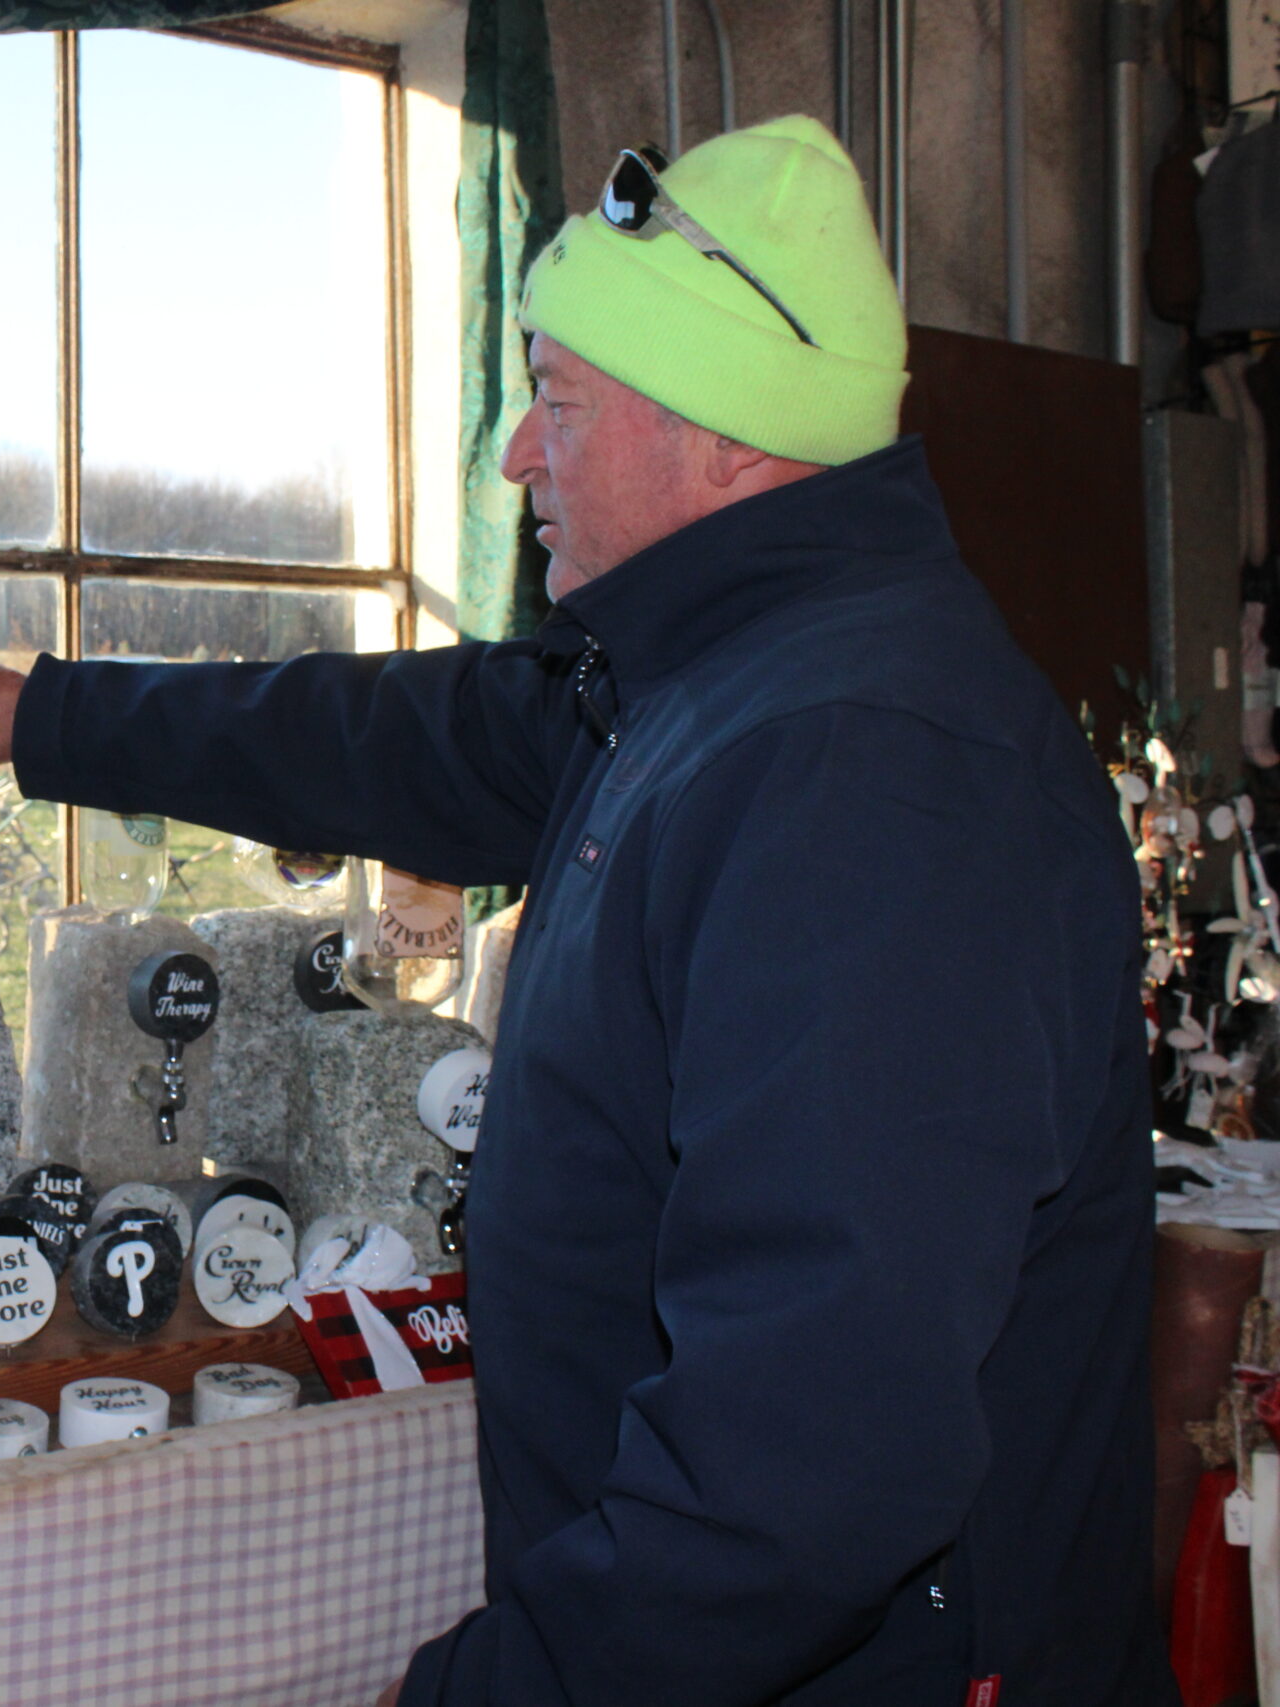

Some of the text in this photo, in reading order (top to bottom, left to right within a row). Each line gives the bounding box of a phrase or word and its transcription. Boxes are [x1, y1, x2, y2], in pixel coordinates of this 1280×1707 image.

[382, 913, 459, 948] FIREBALL
[168, 972, 205, 994] Wine
[155, 996, 212, 1021] Therapy
[33, 1169, 83, 1195] Just
[205, 1244, 262, 1278] Crown
[106, 1240, 156, 1317] P
[207, 1363, 254, 1383] Bad
[231, 1376, 282, 1393] Day
[74, 1384, 143, 1399] Happy
[91, 1398, 147, 1411] Hour
